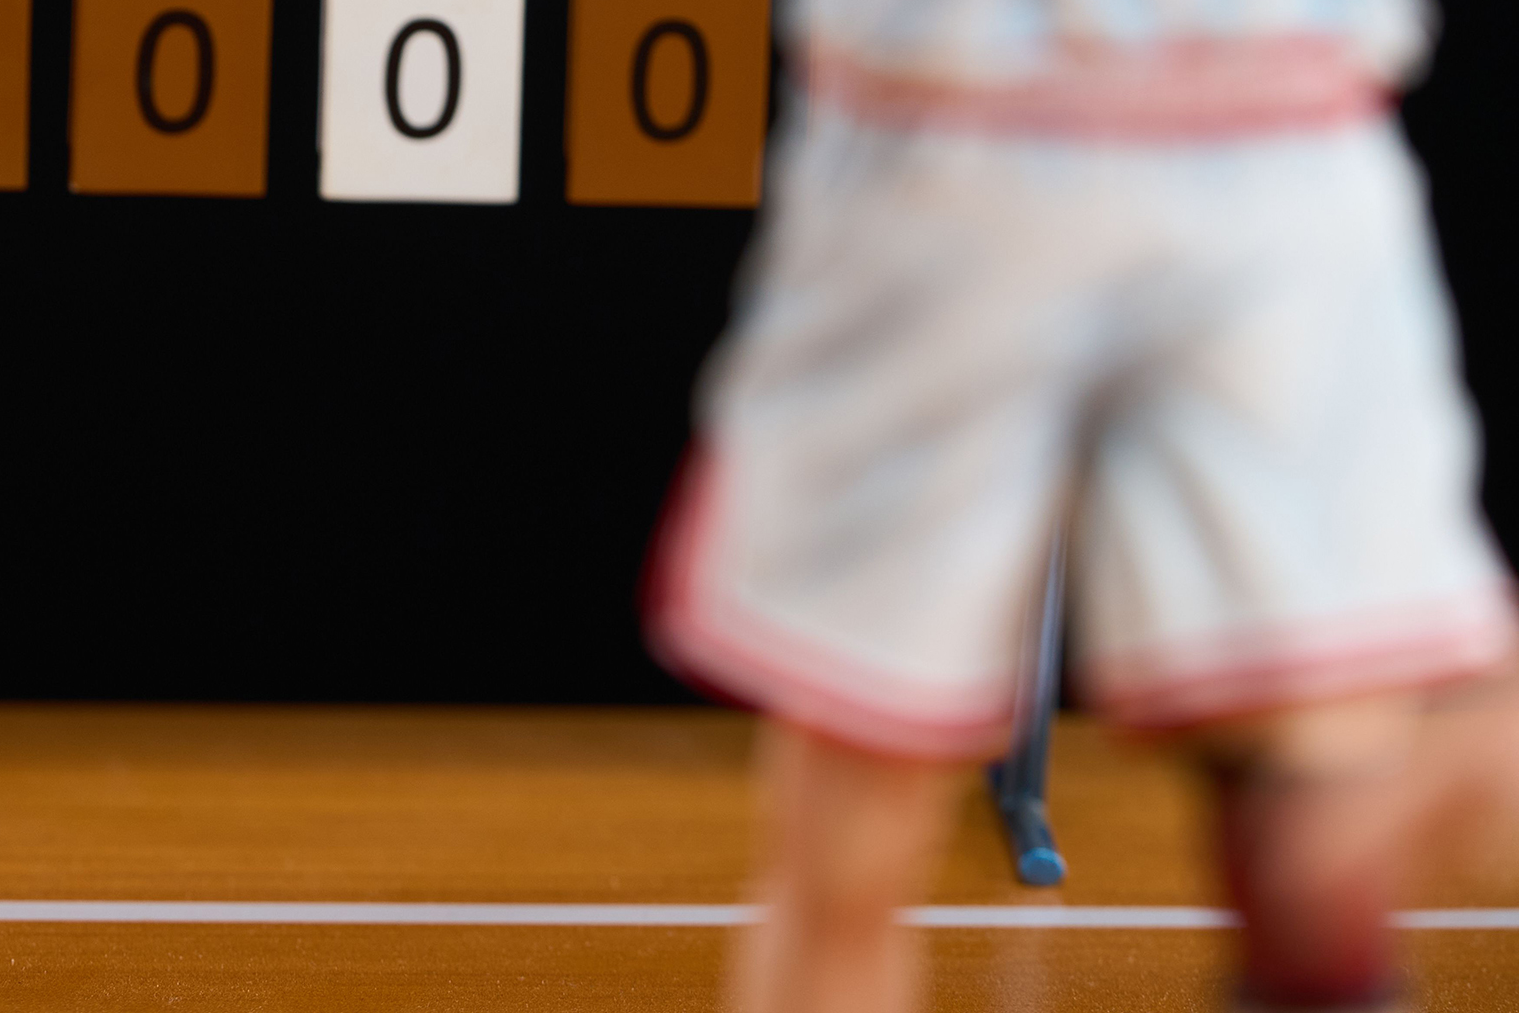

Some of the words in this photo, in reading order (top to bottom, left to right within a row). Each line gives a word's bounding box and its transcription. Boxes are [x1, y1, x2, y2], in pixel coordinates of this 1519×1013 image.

[135, 8, 216, 136] 0
[383, 17, 463, 141] 0
[629, 18, 711, 143] 0
